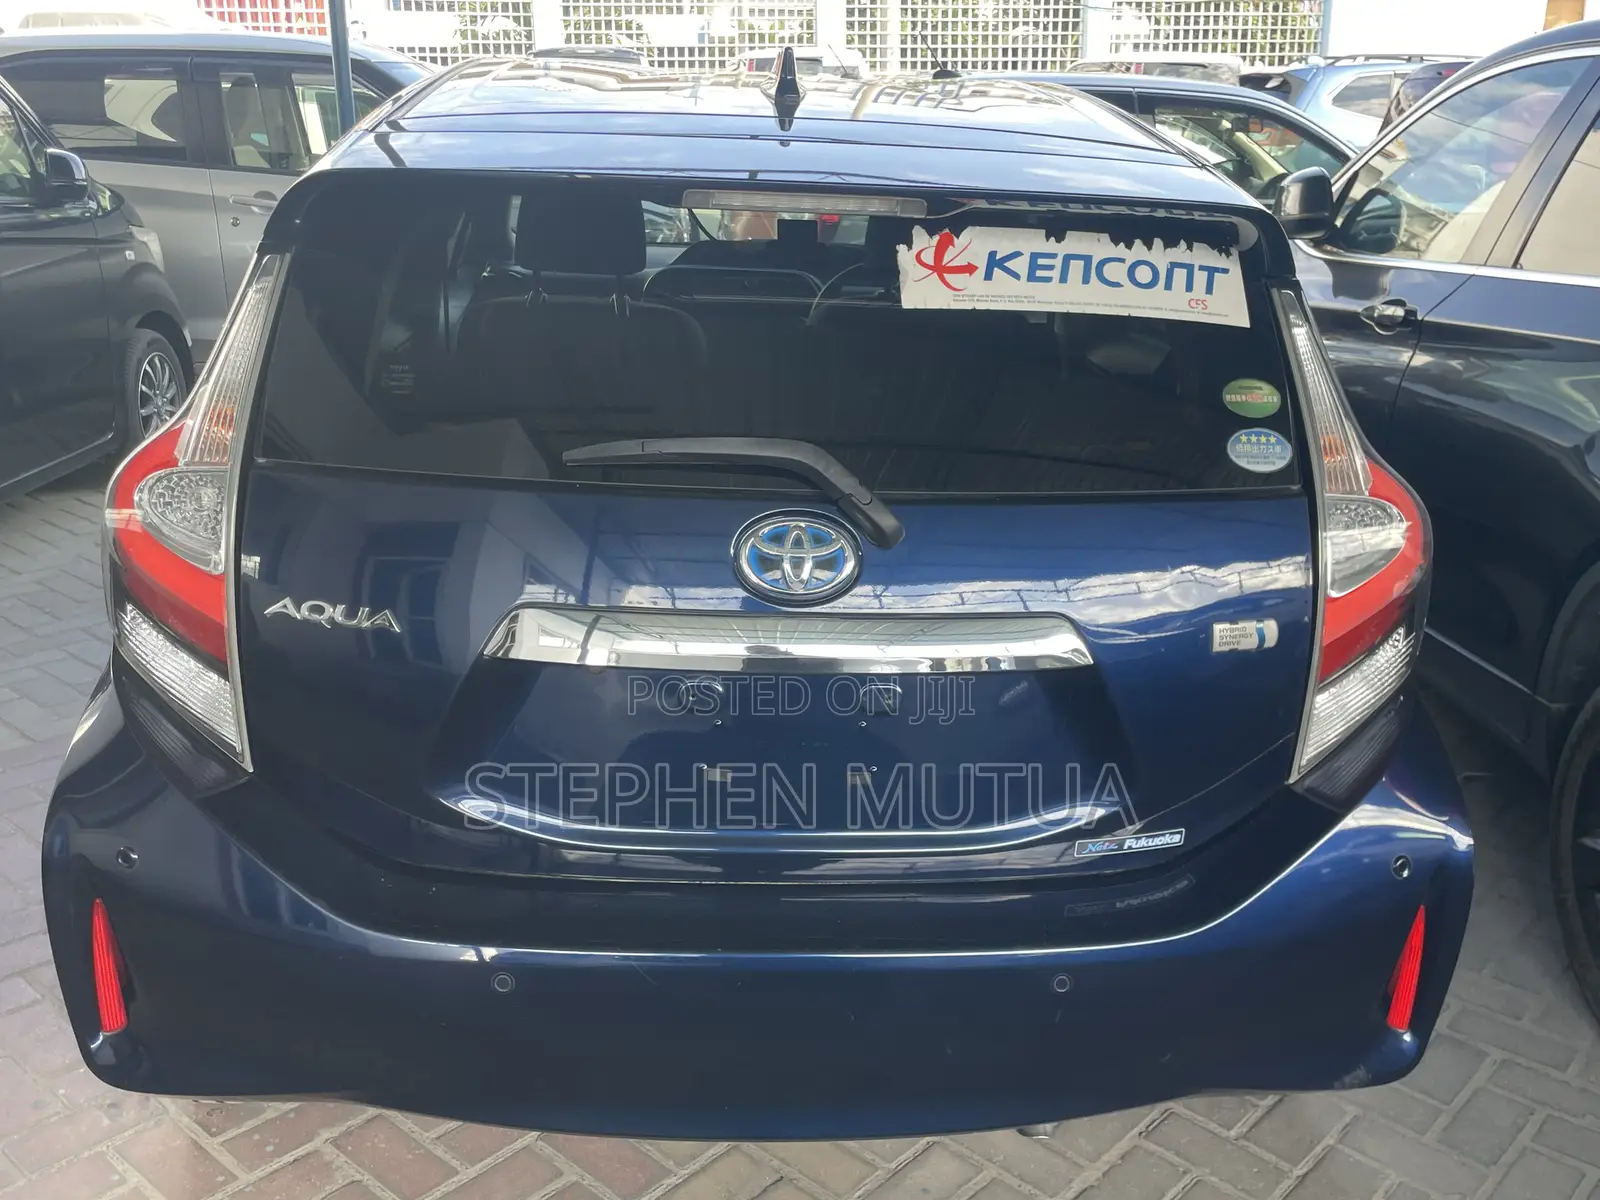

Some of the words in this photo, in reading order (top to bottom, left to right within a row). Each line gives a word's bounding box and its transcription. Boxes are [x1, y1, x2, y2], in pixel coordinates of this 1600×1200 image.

[1187, 298, 1208, 311] CFS
[263, 596, 401, 633] AQUA
[1218, 626, 1247, 635] HYBRID
[1219, 632, 1254, 641] SYNERGY
[1218, 640, 1242, 648] DRIVE
[1081, 841, 1118, 854] Netz
[1122, 834, 1181, 850] Fukuoka
